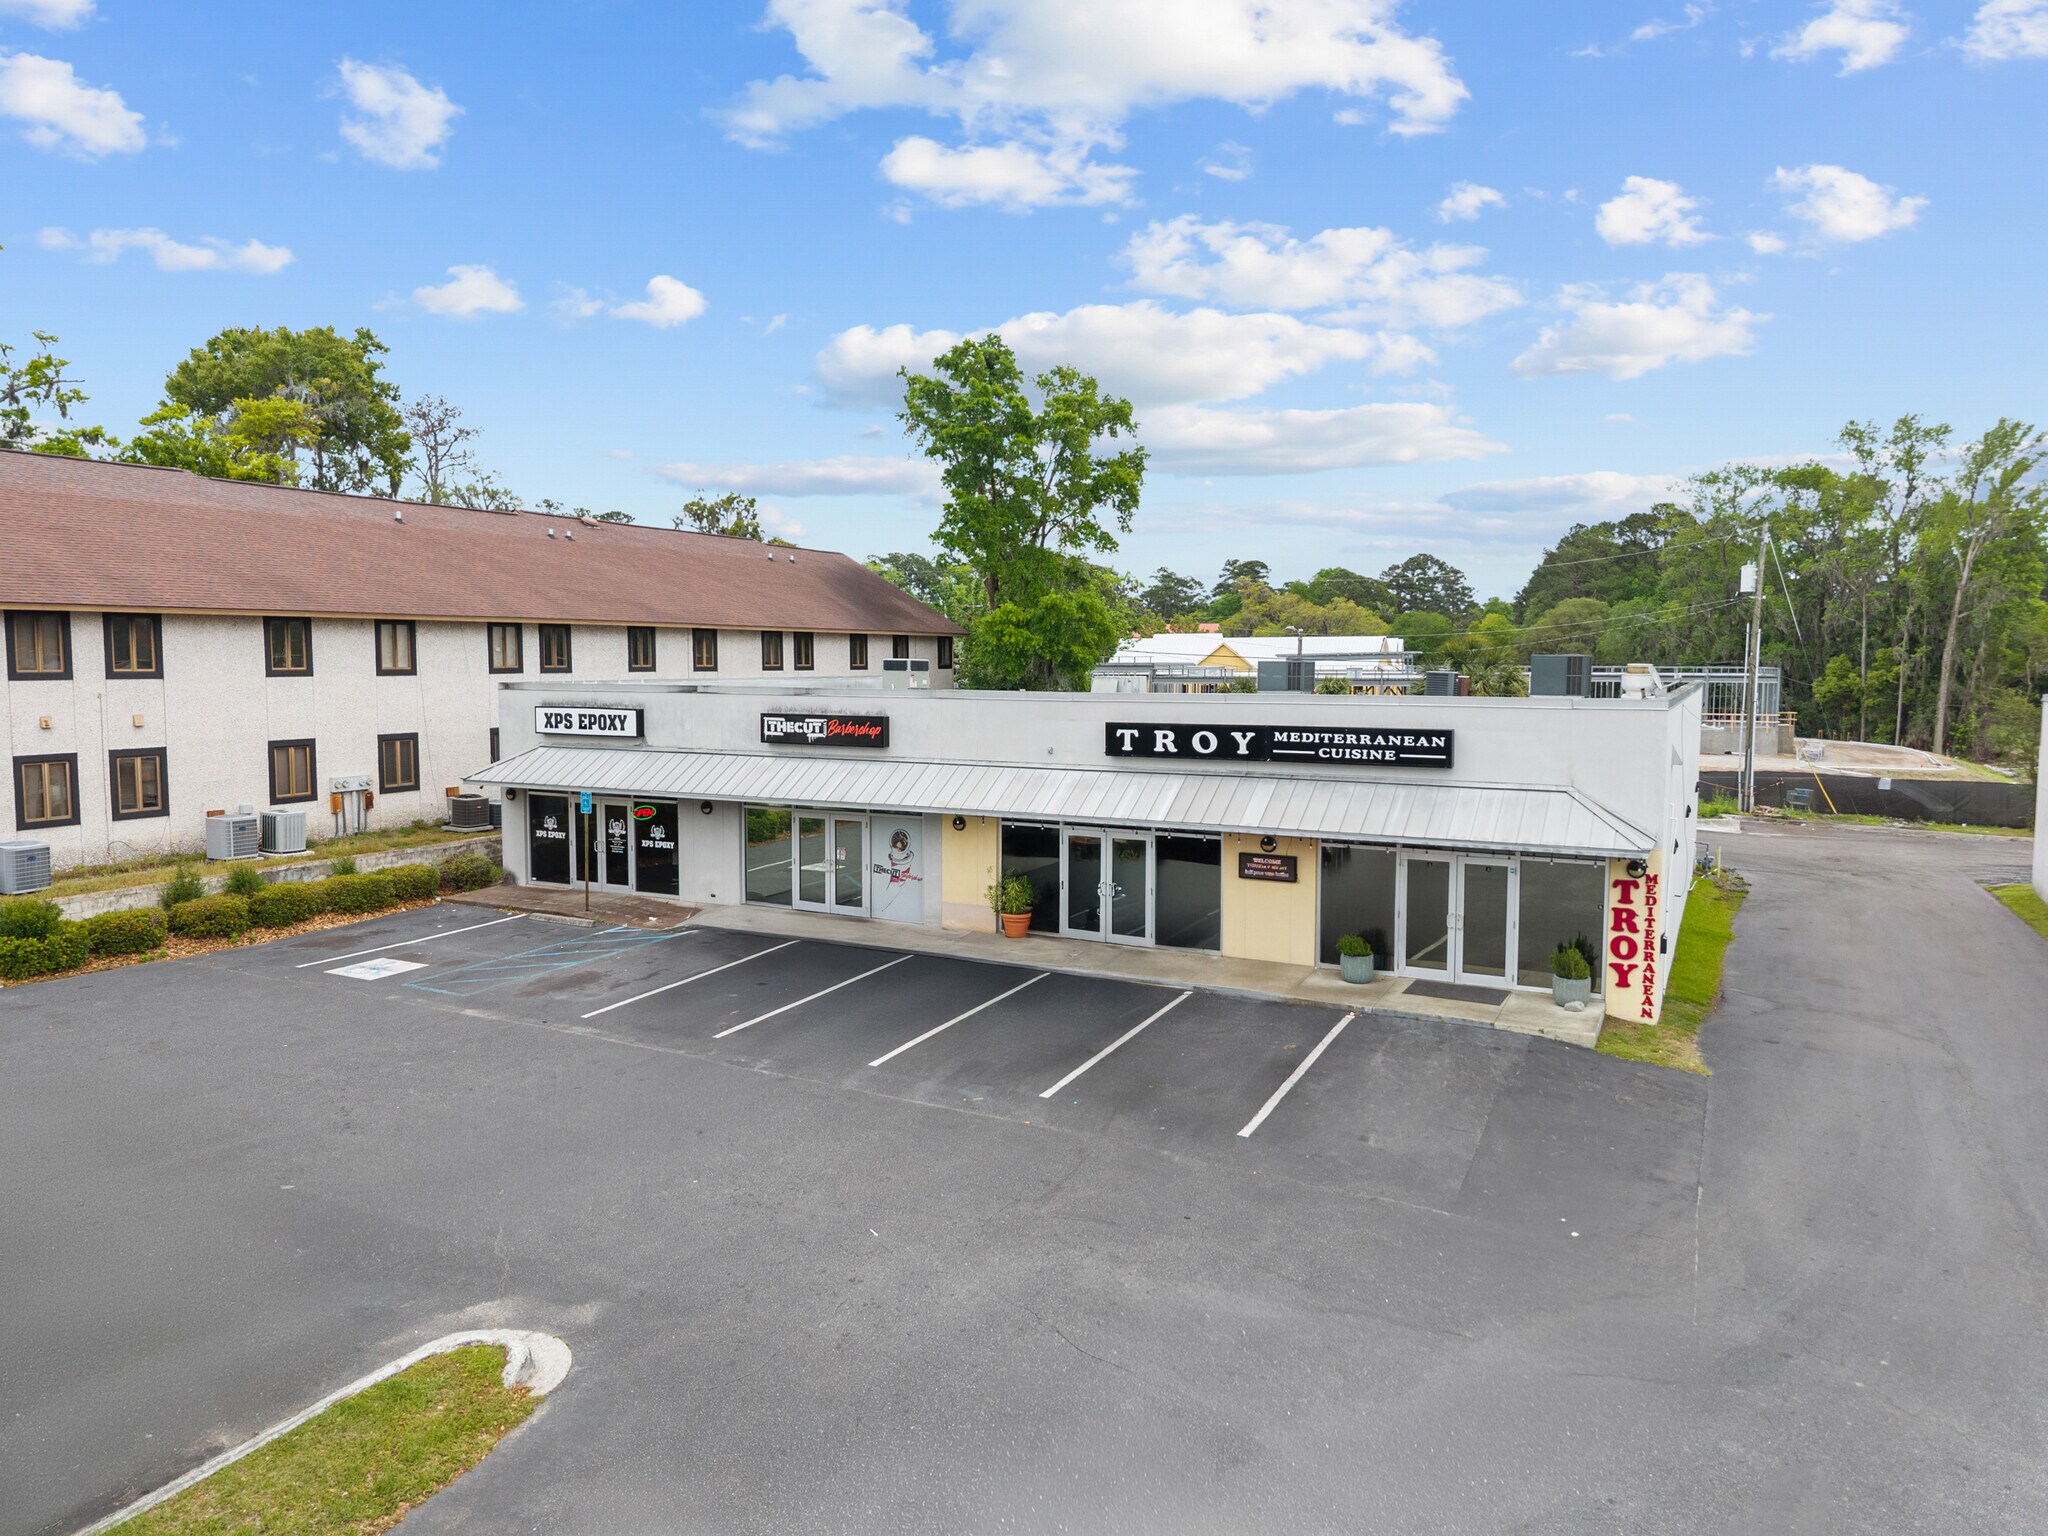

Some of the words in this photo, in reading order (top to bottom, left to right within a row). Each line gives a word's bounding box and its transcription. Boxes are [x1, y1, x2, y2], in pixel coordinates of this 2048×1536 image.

[544, 713, 573, 729] XPS
[578, 714, 627, 731] EPOXY
[828, 719, 881, 739] Barbershop
[1116, 729, 1256, 754] TROY
[1274, 732, 1446, 747] MEDITERRANEAN
[1318, 748, 1396, 760] CUISINE
[633, 808, 655, 817] OPEN
[536, 830, 547, 838] XPS
[548, 831, 566, 839] EPOXY
[641, 840, 653, 848] XPS
[655, 841, 675, 849] EPOXY
[1609, 879, 1640, 988] TROY
[1640, 873, 1658, 1019] MEDITERRANEAN
